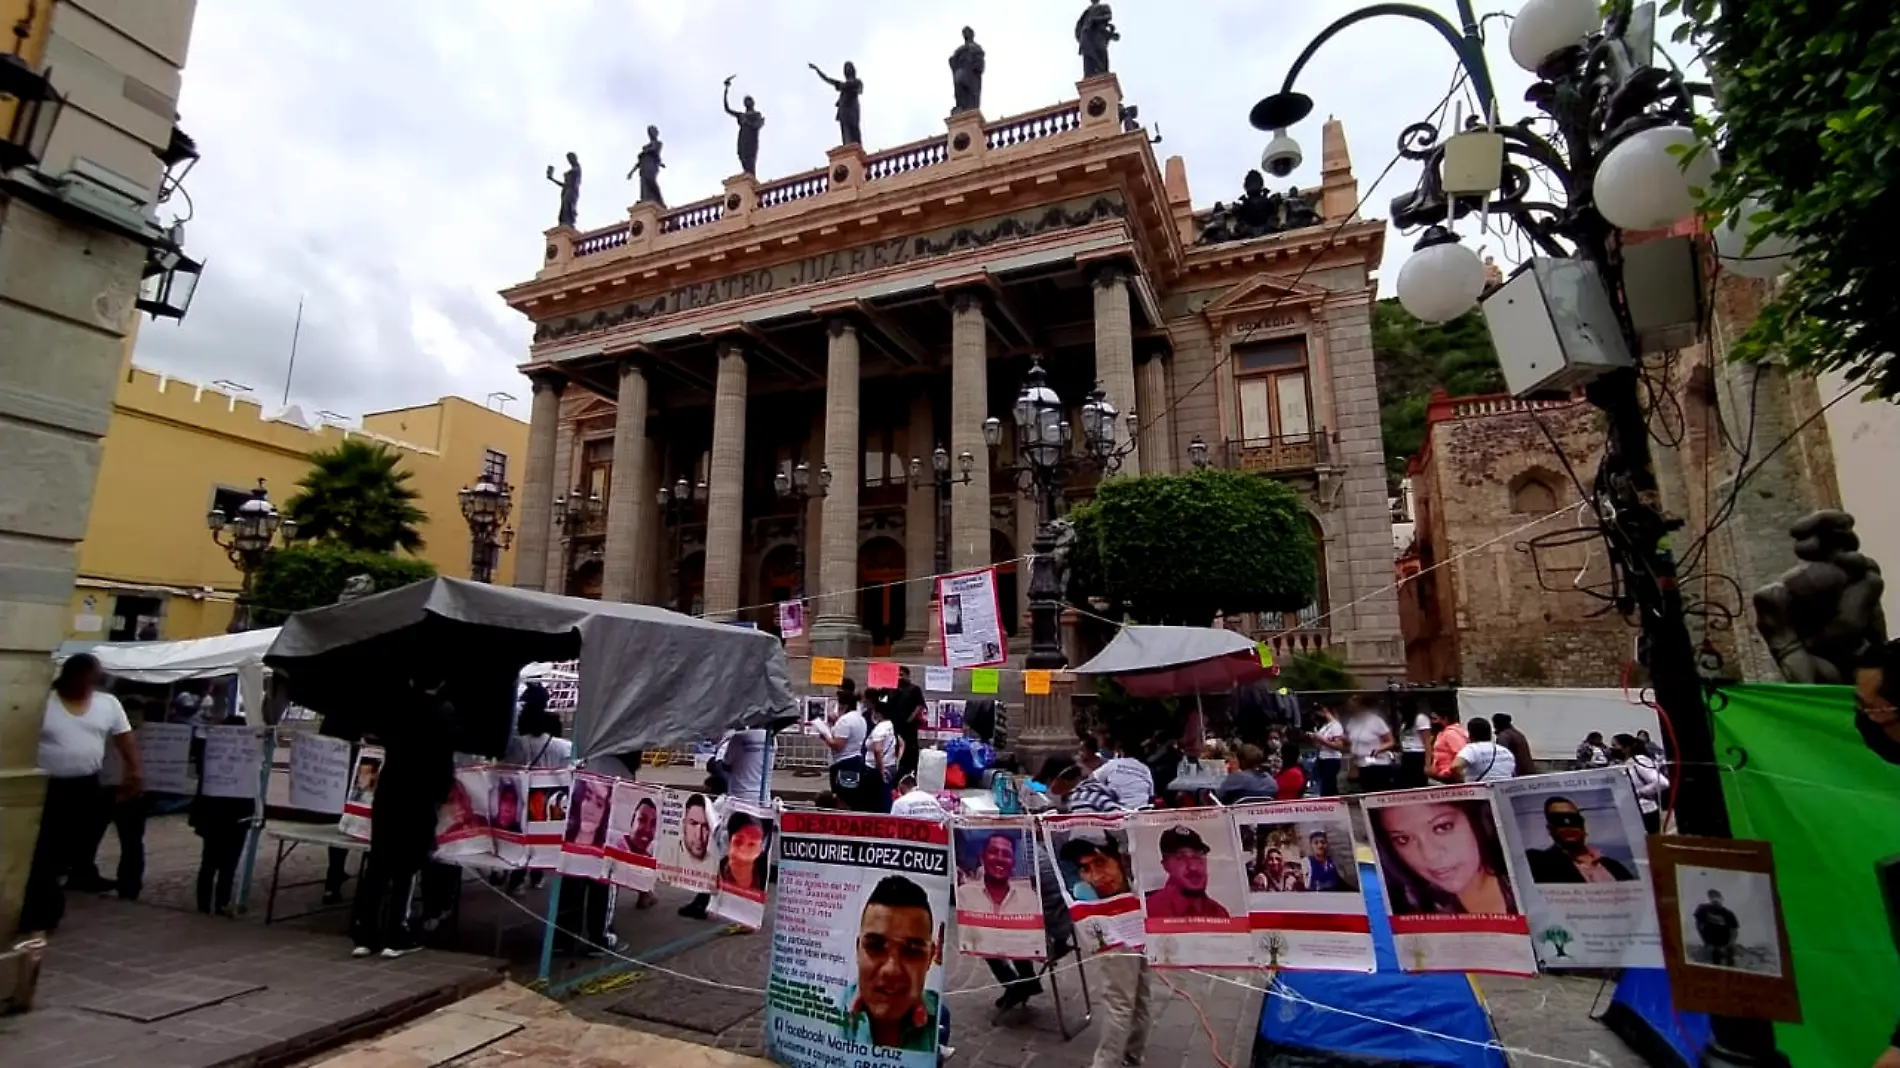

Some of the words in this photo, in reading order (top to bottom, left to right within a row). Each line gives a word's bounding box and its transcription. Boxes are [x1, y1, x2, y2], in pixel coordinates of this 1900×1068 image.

[671, 268, 773, 307] TEATRO
[796, 815, 931, 842] DESAPARECIDO
[783, 841, 818, 859] LUCIO
[818, 844, 855, 862] URIEL
[857, 843, 900, 866] LÓPEZ
[903, 851, 944, 872] CRUZ
[828, 1034, 868, 1056] Martha
[872, 1045, 903, 1061] Cruz
